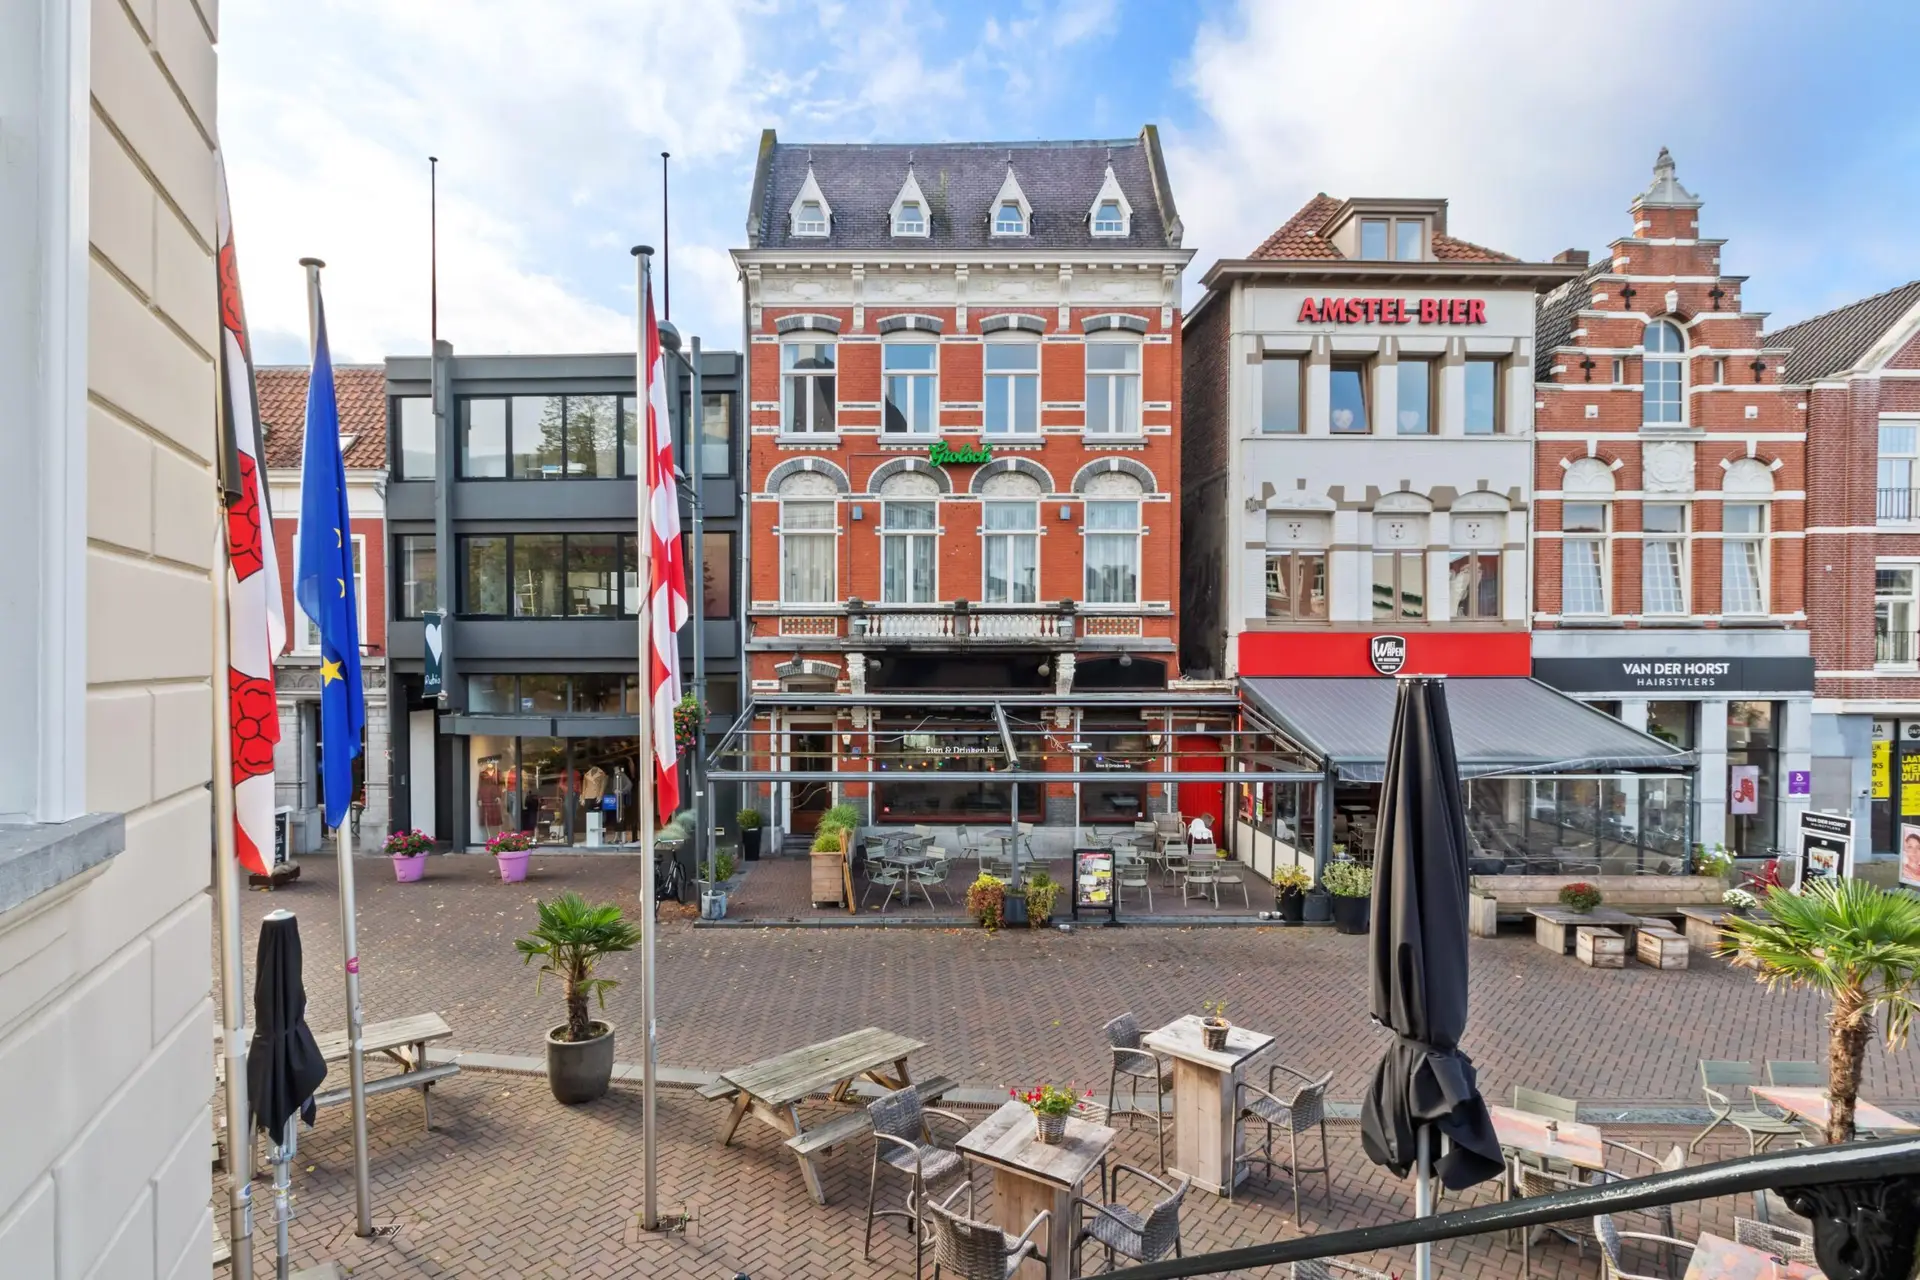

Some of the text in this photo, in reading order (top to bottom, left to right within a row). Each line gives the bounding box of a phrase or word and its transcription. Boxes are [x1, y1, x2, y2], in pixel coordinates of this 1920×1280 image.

[1298, 297, 1487, 324] AMSTEL BIER
[1622, 663, 1730, 675] VAN DER HORST
[1636, 678, 1715, 686] HAIRSTYLERS
